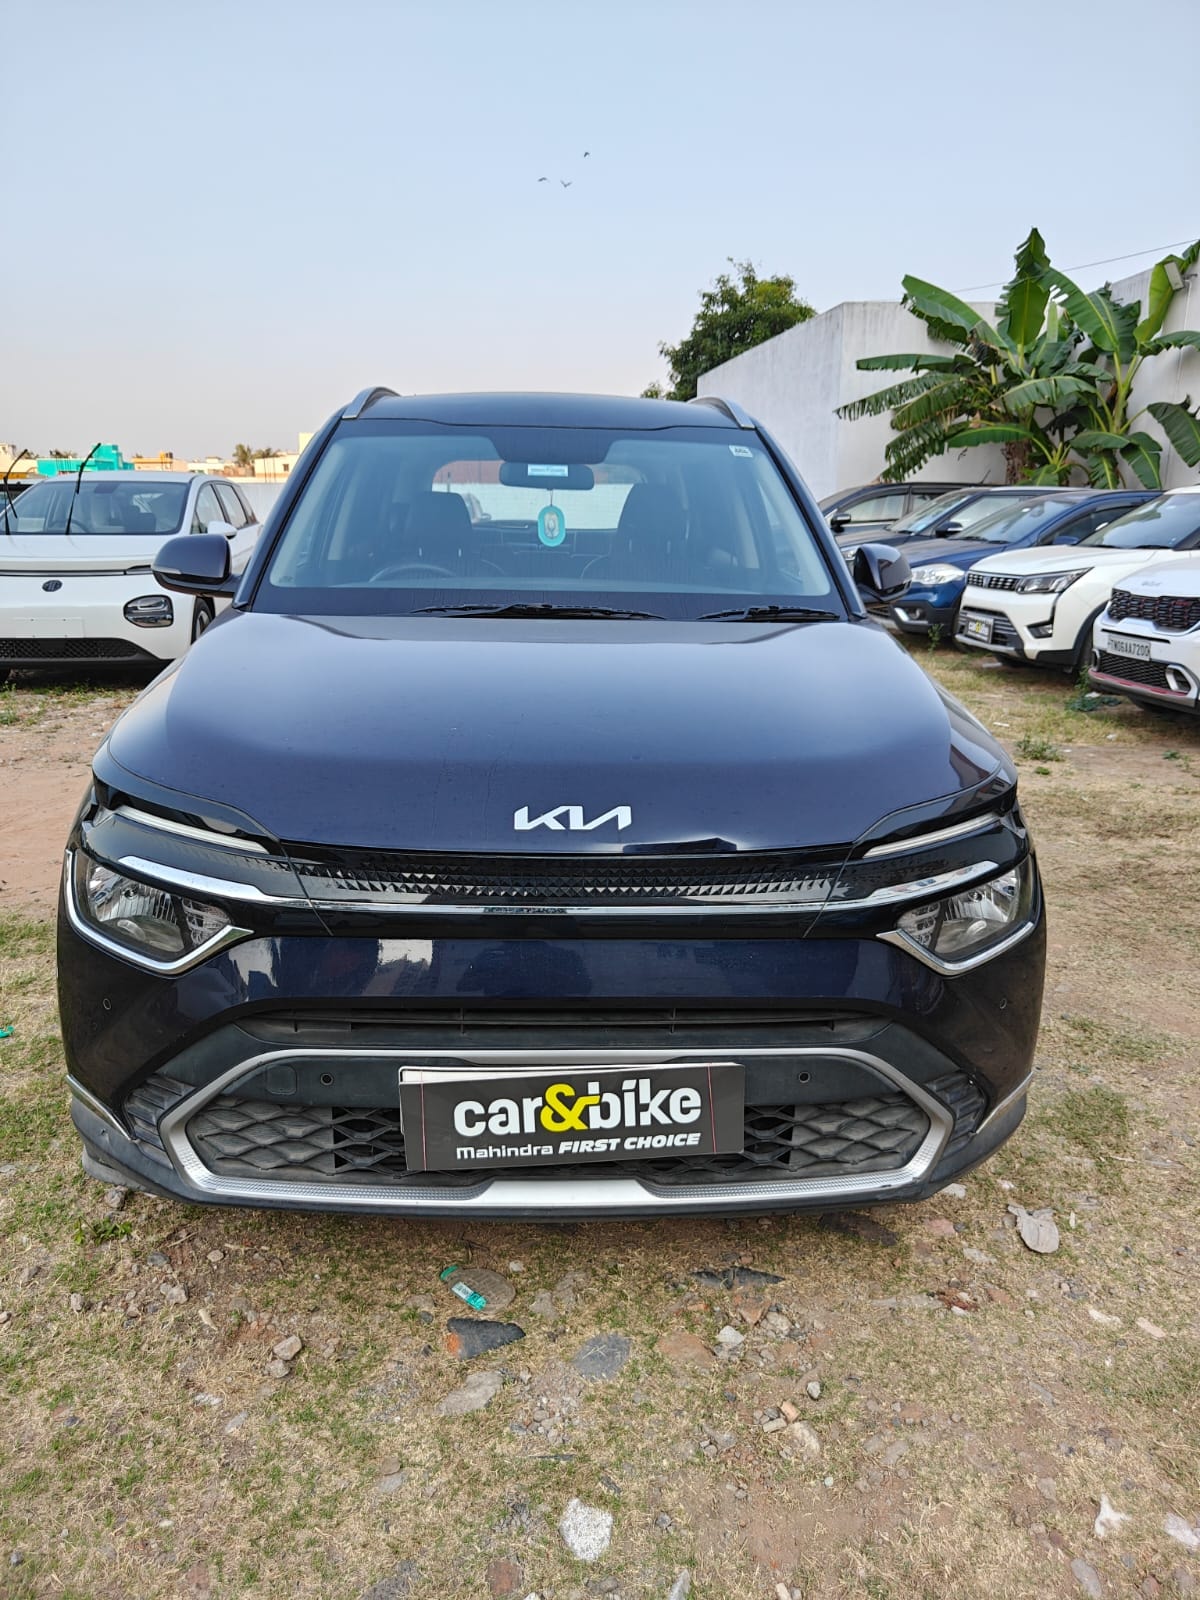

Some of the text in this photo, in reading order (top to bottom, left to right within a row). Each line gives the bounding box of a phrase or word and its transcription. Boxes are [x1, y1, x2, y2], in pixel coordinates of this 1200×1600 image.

[514, 805, 632, 830] KIA
[456, 1133, 701, 1159] Mahindra FIRST CHOICE
